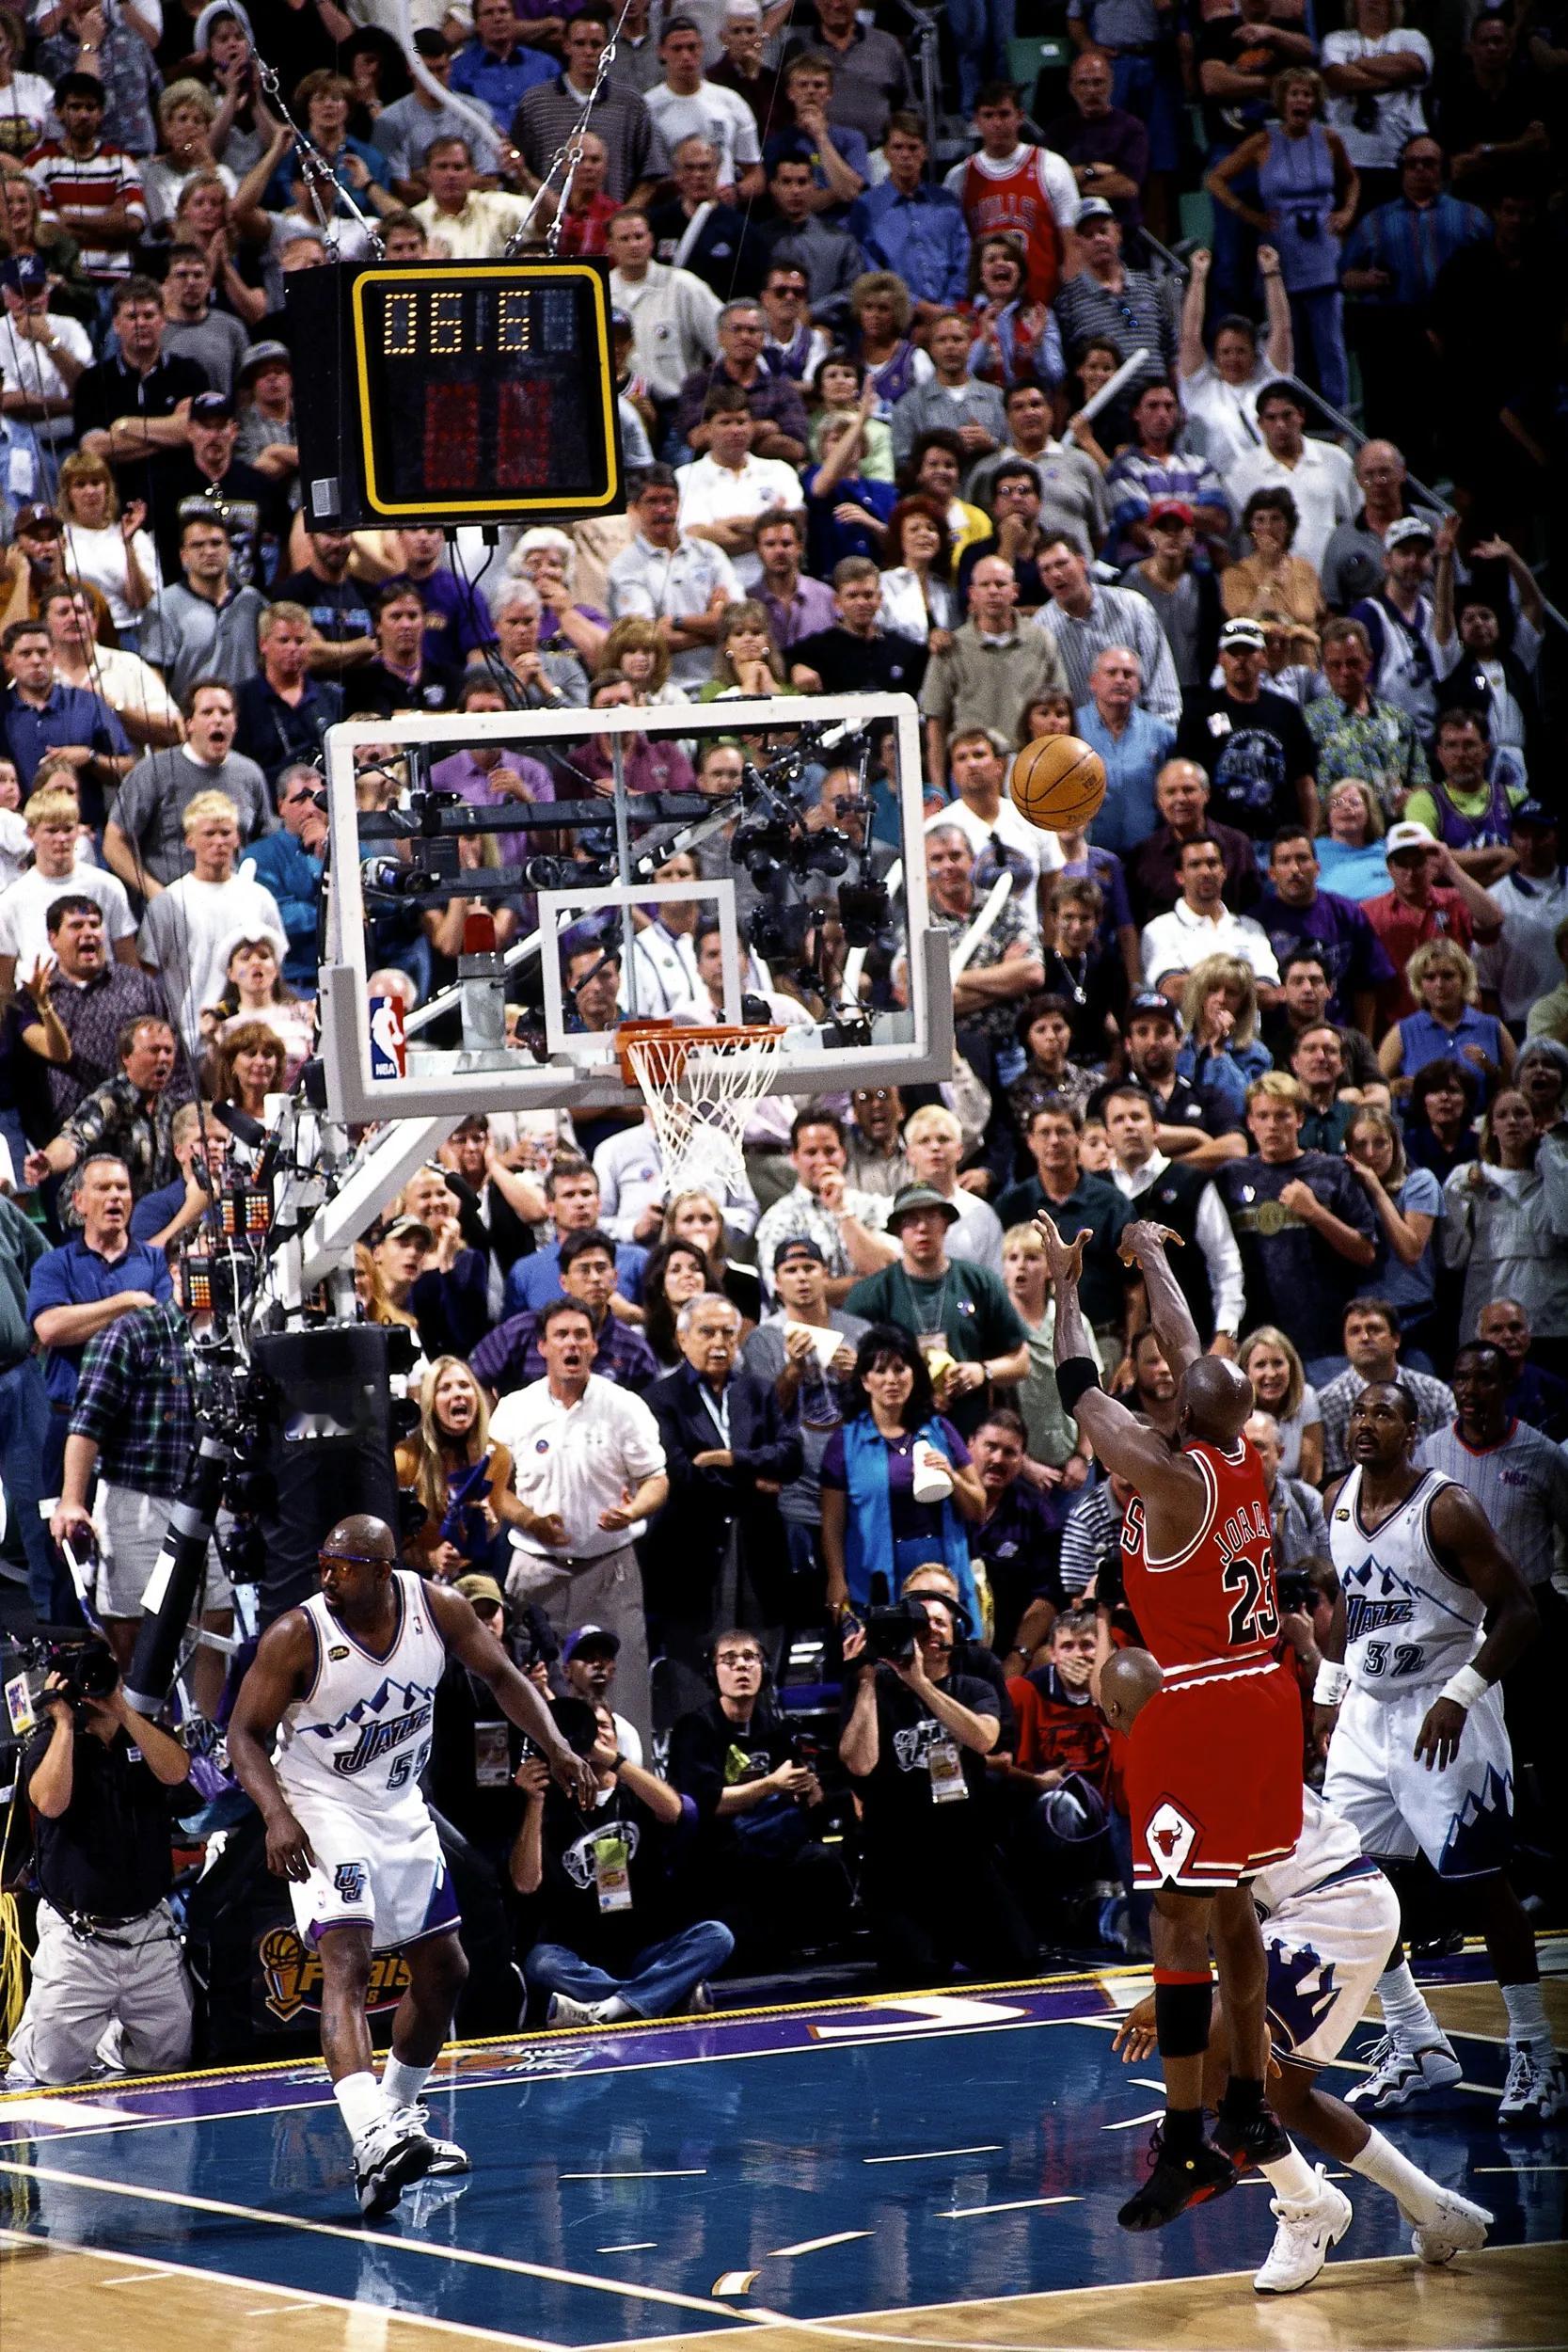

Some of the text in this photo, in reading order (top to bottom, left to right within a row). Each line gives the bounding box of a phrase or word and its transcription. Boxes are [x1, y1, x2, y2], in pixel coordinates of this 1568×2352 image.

[383, 289, 531, 356] 06.6
[375, 1062, 396, 1075] NBA
[1222, 1547, 1280, 1646] 23
[1363, 1640, 1426, 1677] 32
